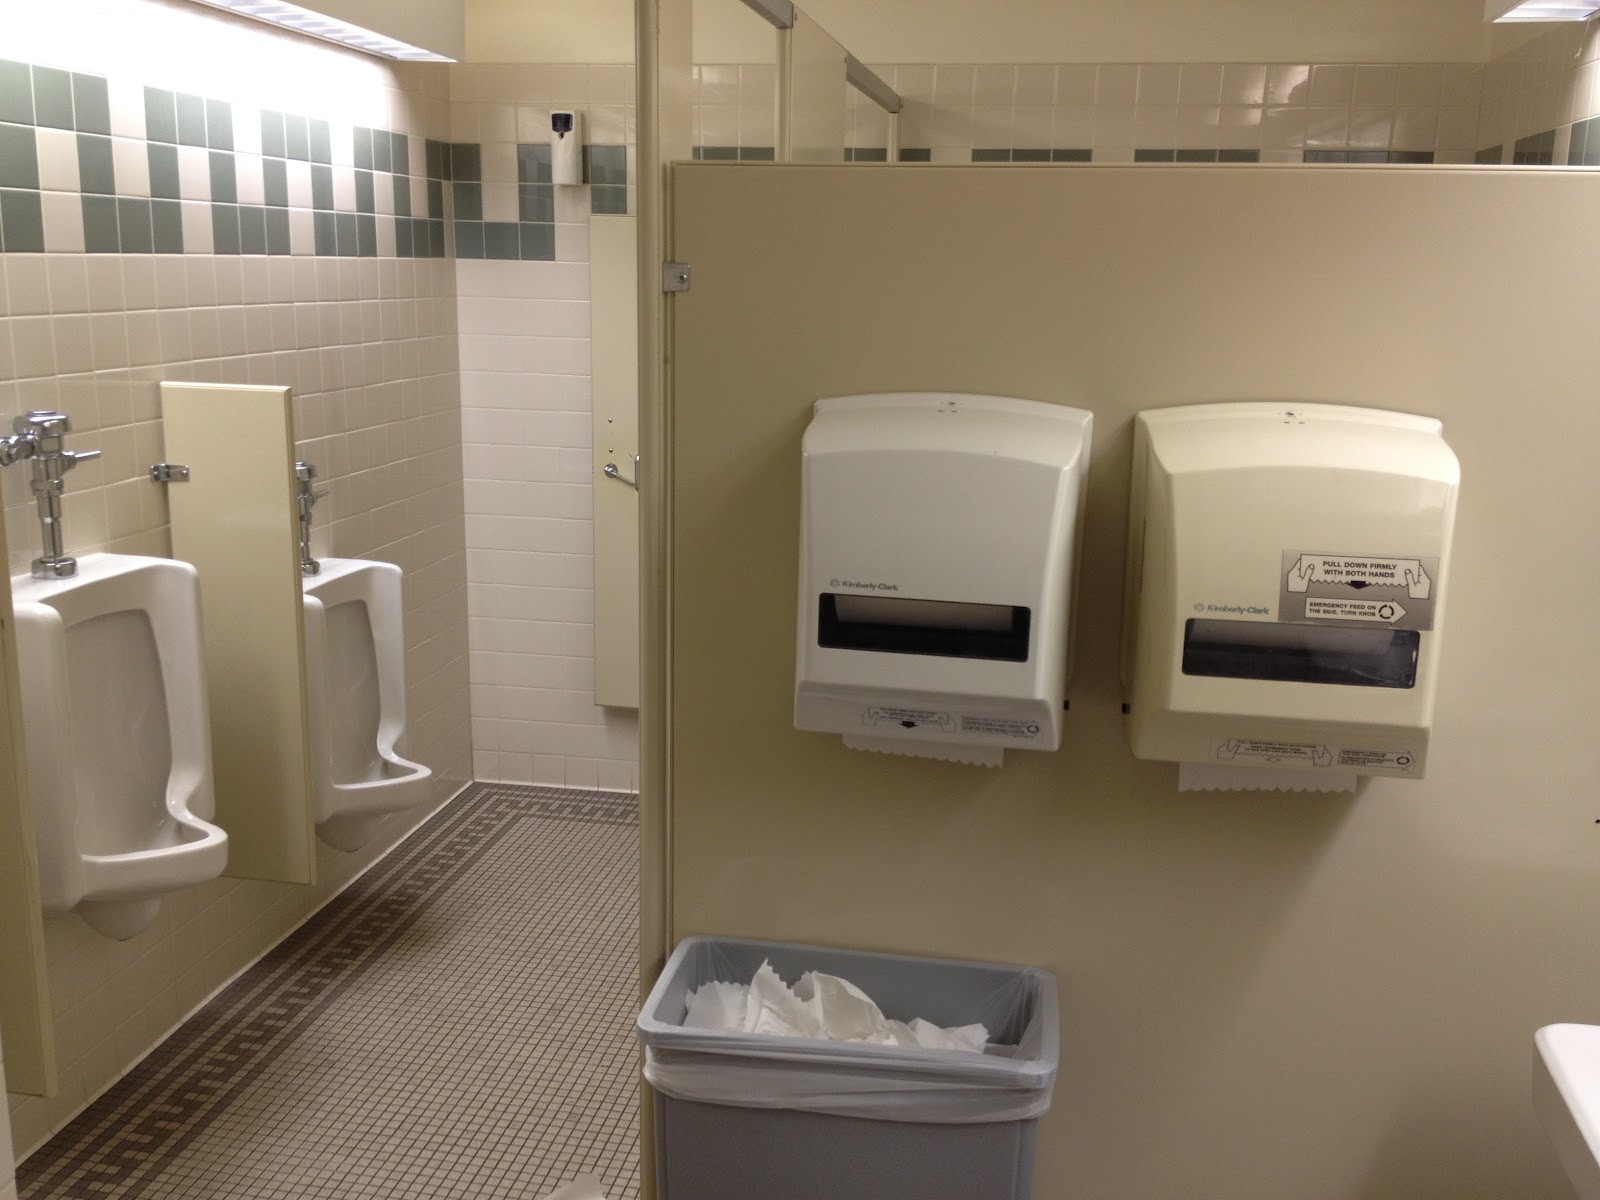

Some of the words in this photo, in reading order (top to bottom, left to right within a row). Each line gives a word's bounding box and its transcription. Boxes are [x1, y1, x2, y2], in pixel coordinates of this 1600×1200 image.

[1322, 560, 1342, 568] PULL
[1344, 561, 1368, 569] DOWN
[1323, 568, 1343, 576] WITH
[842, 580, 899, 591] Kimberly-Clark
[1207, 604, 1270, 615] Kimberly-Clark
[1309, 601, 1348, 609] EMERGENCY
